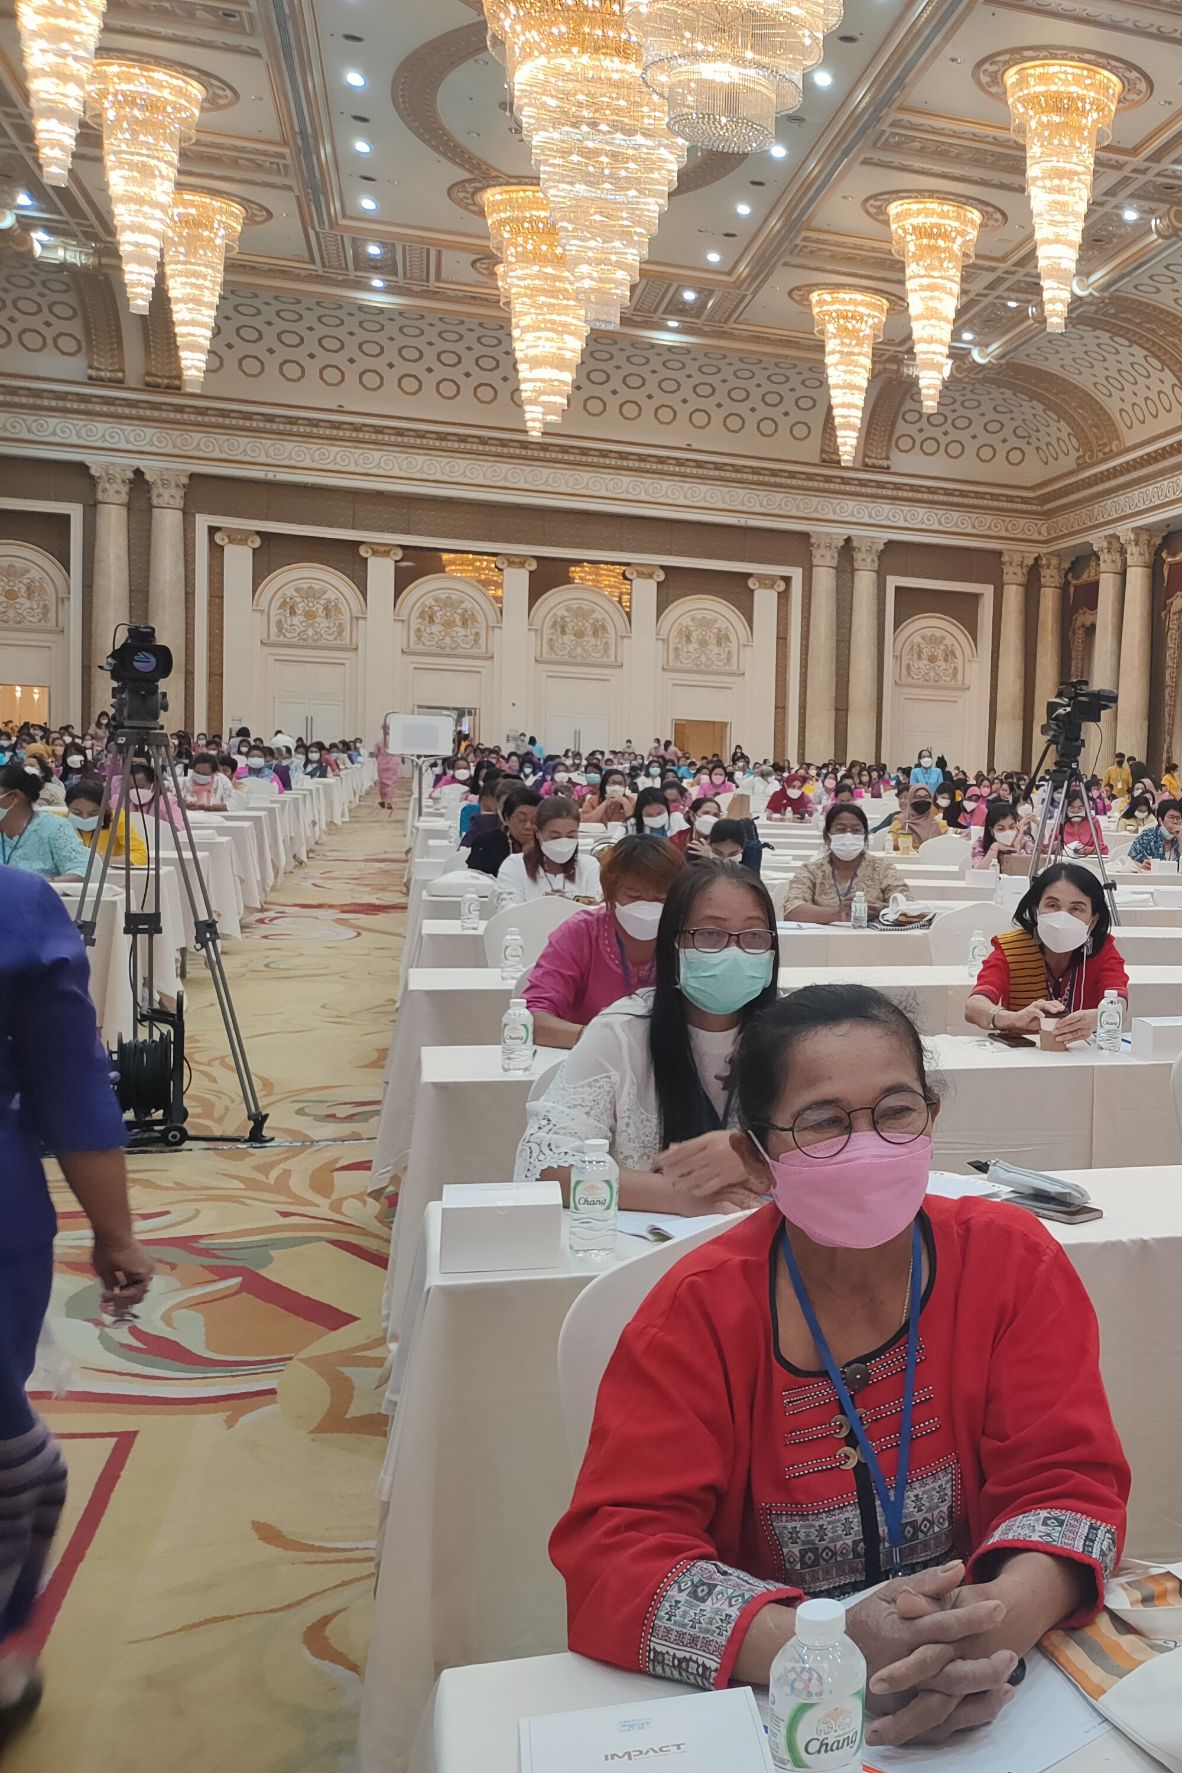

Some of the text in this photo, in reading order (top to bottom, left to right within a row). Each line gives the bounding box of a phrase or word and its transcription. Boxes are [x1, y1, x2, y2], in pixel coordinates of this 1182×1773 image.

[578, 1196, 607, 1206] Chang
[604, 1742, 686, 1761] IMPACT
[804, 1730, 858, 1756] Chang
